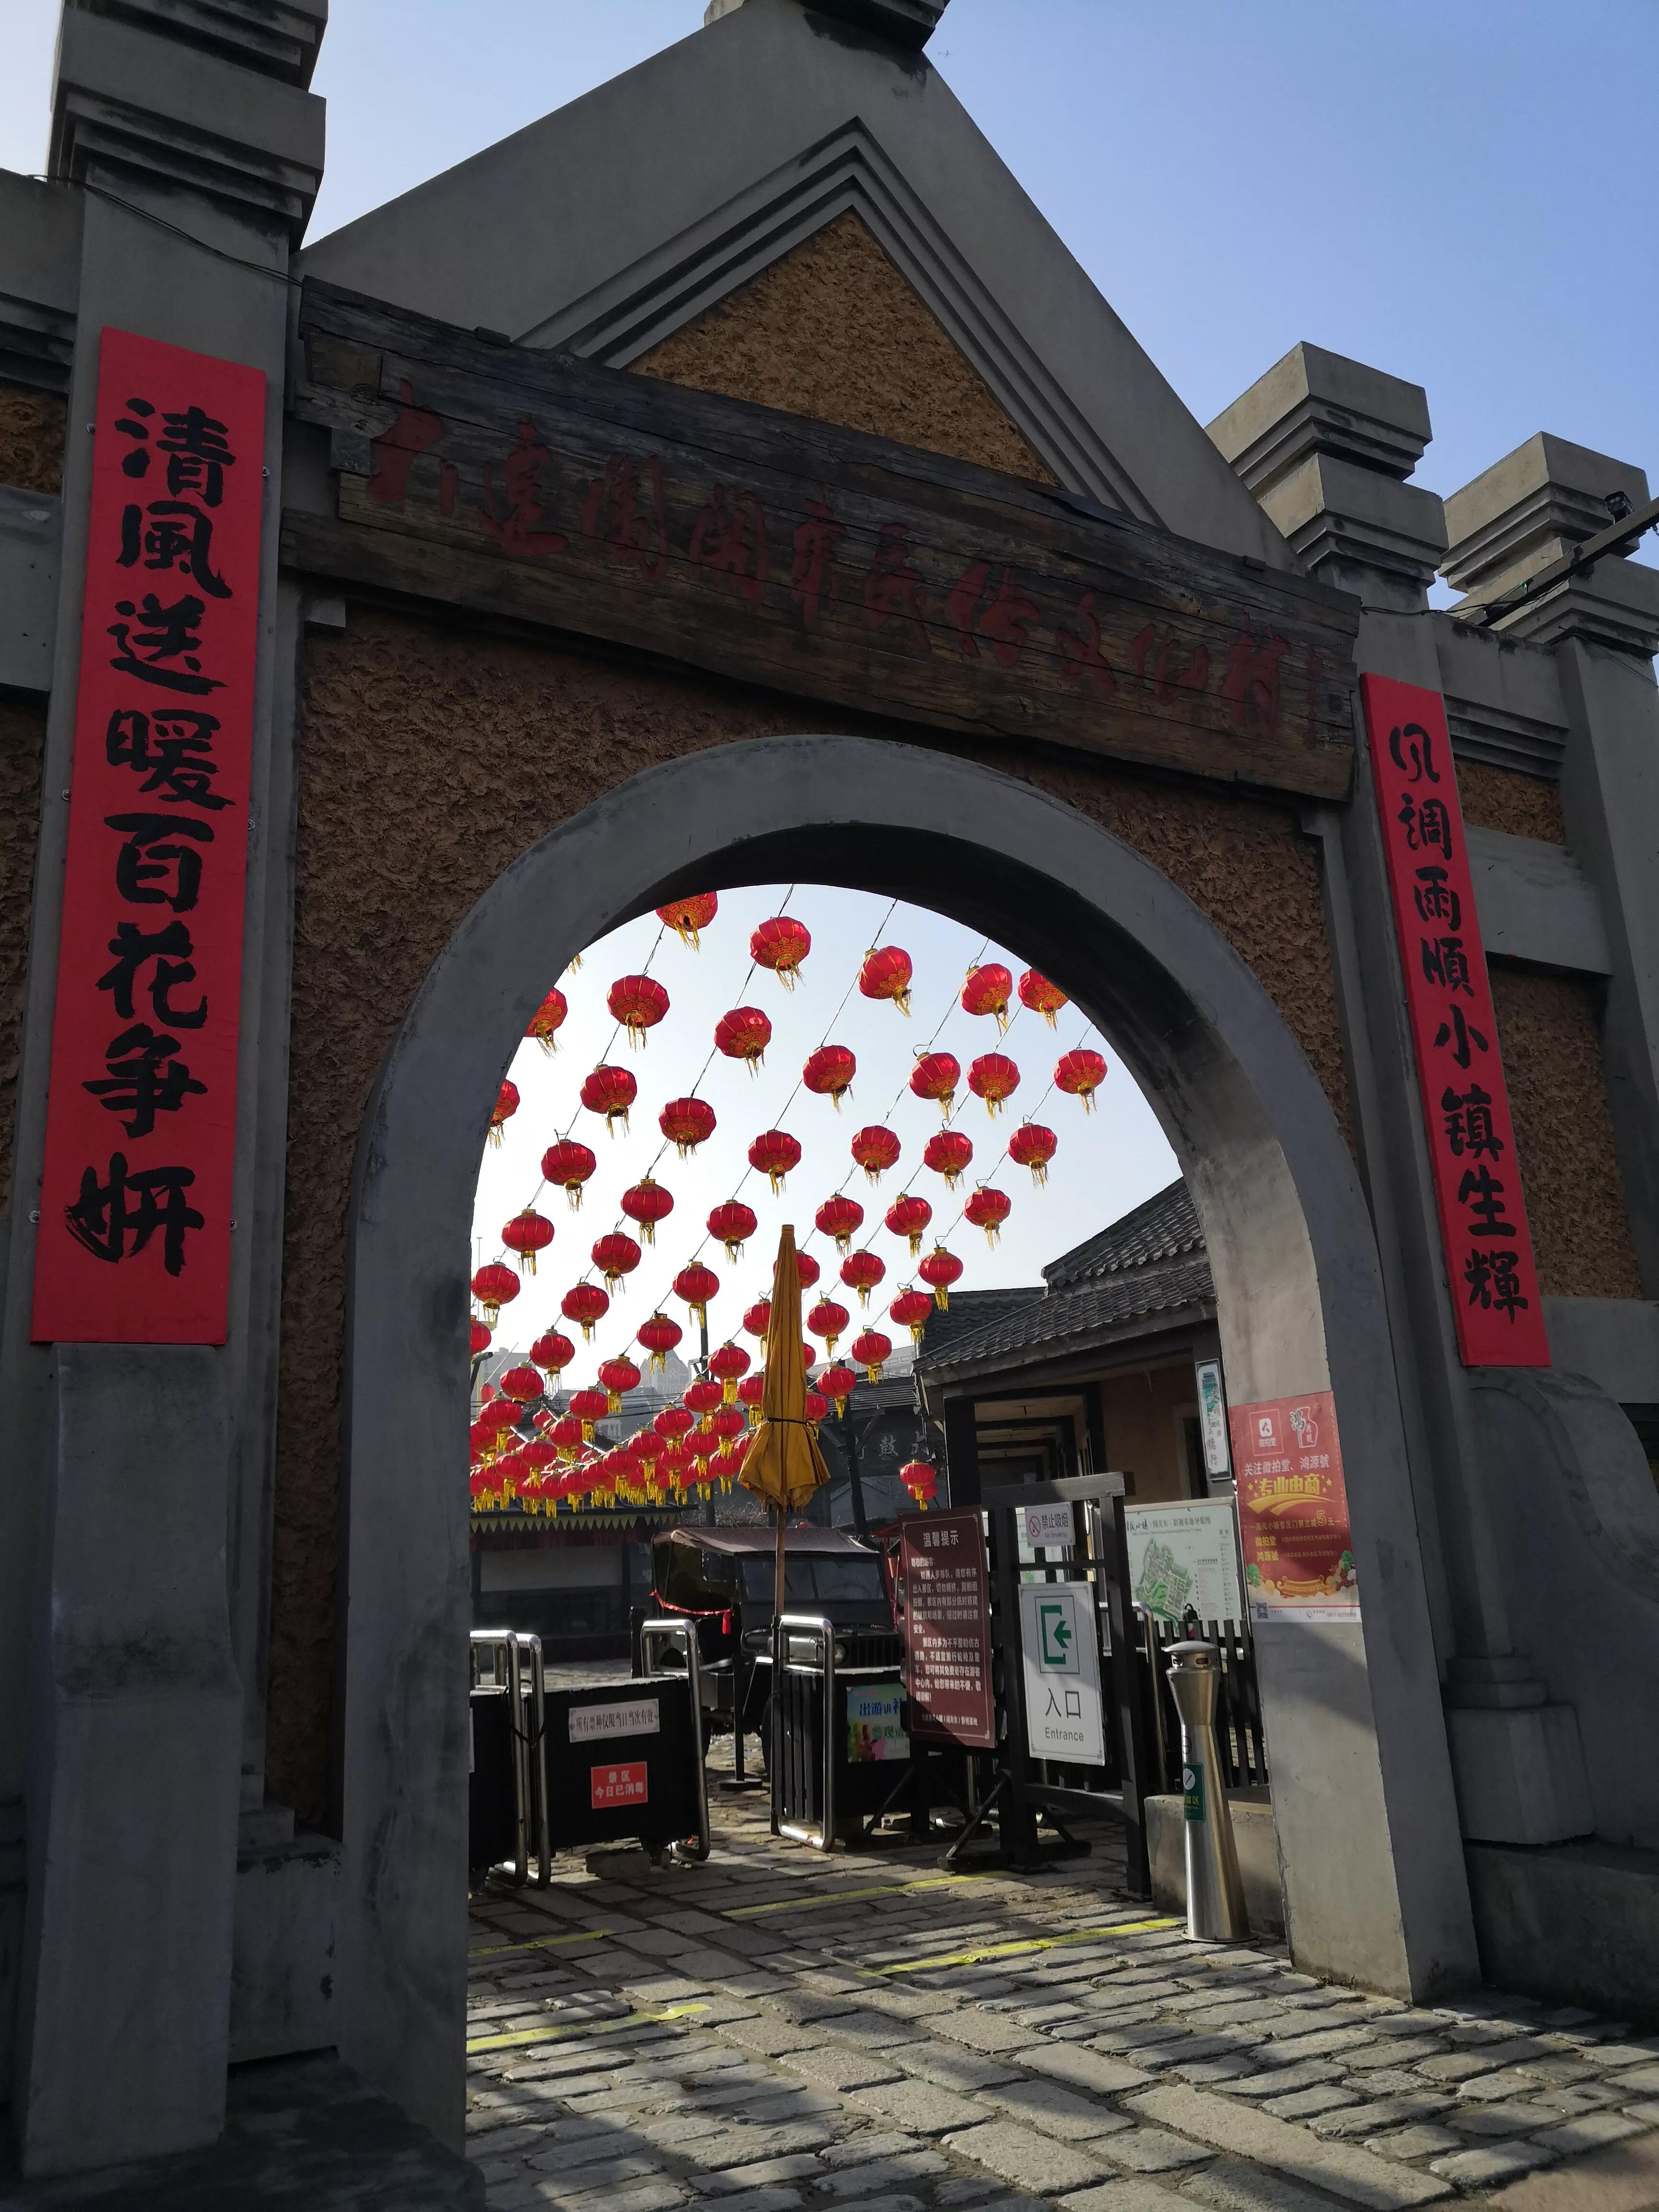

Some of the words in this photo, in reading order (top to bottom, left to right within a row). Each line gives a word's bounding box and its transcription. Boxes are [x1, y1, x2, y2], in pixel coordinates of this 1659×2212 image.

[1042, 1513, 1069, 1529] 禁止吸烟
[924, 1530, 959, 1547] 温馨提示
[1046, 1688, 1081, 1719] 入口
[577, 1708, 653, 1732] 所有票种仅限当日当次有效
[1045, 1728, 1084, 1742] Entrance
[609, 1770, 630, 1784] 景区
[595, 1781, 643, 1799] 今日已消毒
